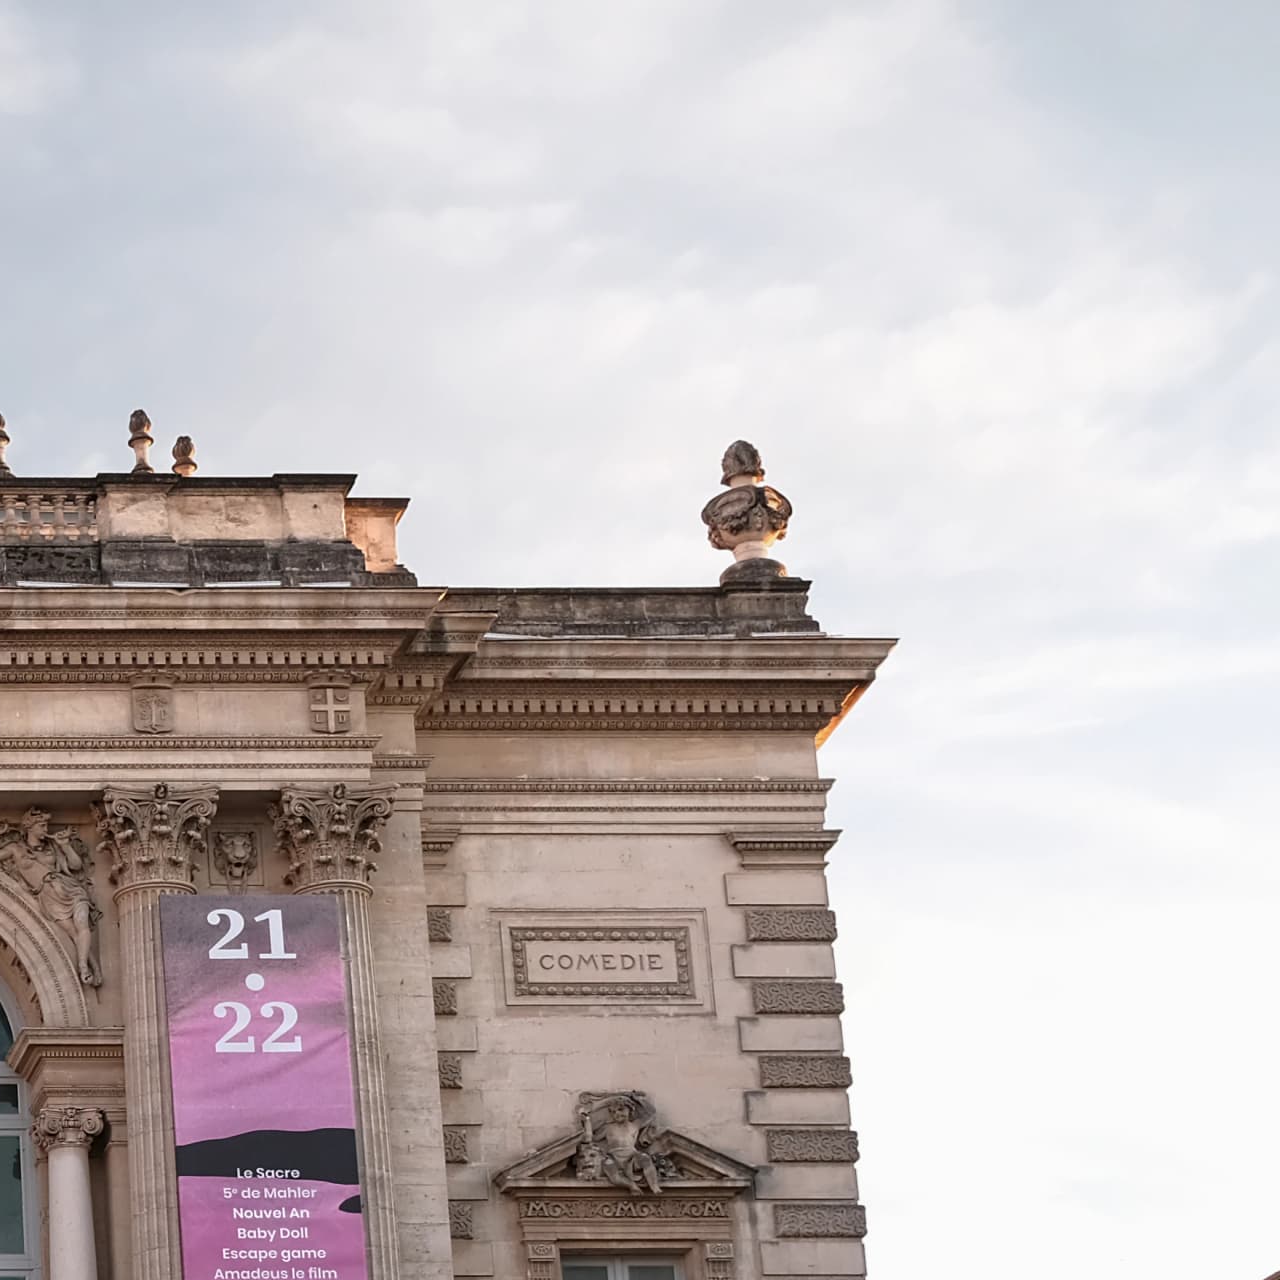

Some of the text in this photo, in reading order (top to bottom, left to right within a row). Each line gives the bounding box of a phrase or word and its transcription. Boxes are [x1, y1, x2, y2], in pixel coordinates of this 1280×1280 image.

[206, 908, 297, 960] 21
[540, 954, 663, 971] COMEDIE
[213, 1001, 303, 1053] 22
[236, 1167, 301, 1179] Le Sacre
[241, 1187, 260, 1199] de
[264, 1186, 317, 1199] Mahler
[233, 1207, 310, 1219] Nouvel An
[237, 1227, 309, 1242] Baby Doll
[222, 1248, 327, 1262] Escape game
[214, 1267, 338, 1280] Amadeus le film
